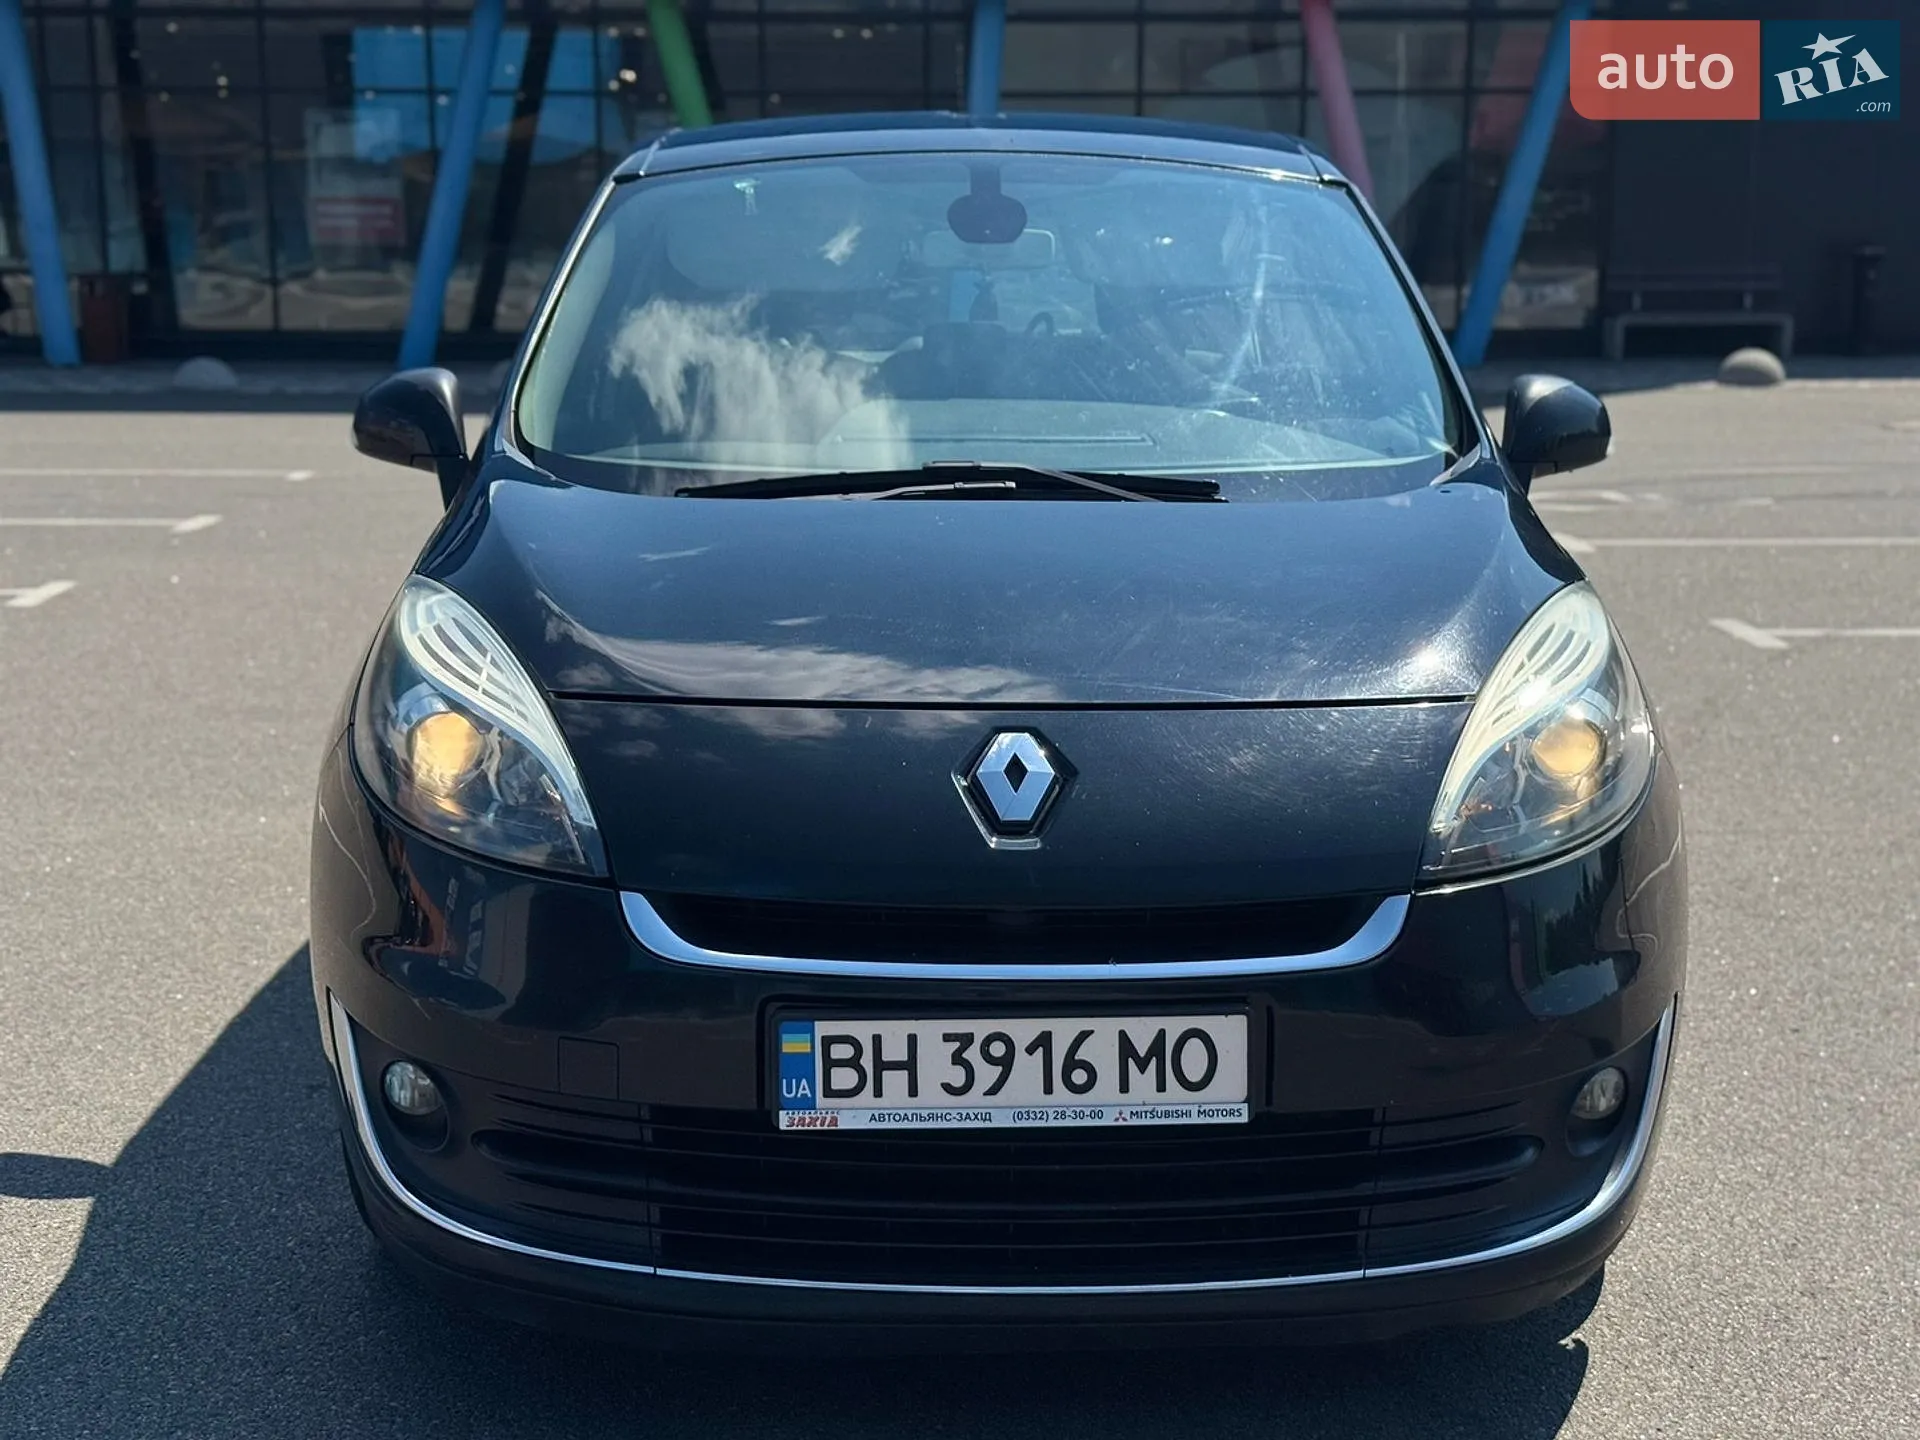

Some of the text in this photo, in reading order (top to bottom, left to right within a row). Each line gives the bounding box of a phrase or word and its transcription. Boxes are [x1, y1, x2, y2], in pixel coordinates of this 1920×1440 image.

[821, 1027, 1217, 1098] BH 3916 MO
[782, 1079, 811, 1098] UA
[869, 1109, 1104, 1123] АВТОАЛЬЯНС-ЗАХІД (0332) 28-30-00
[1130, 1108, 1242, 1119] MITSUBISHI MOTORS
